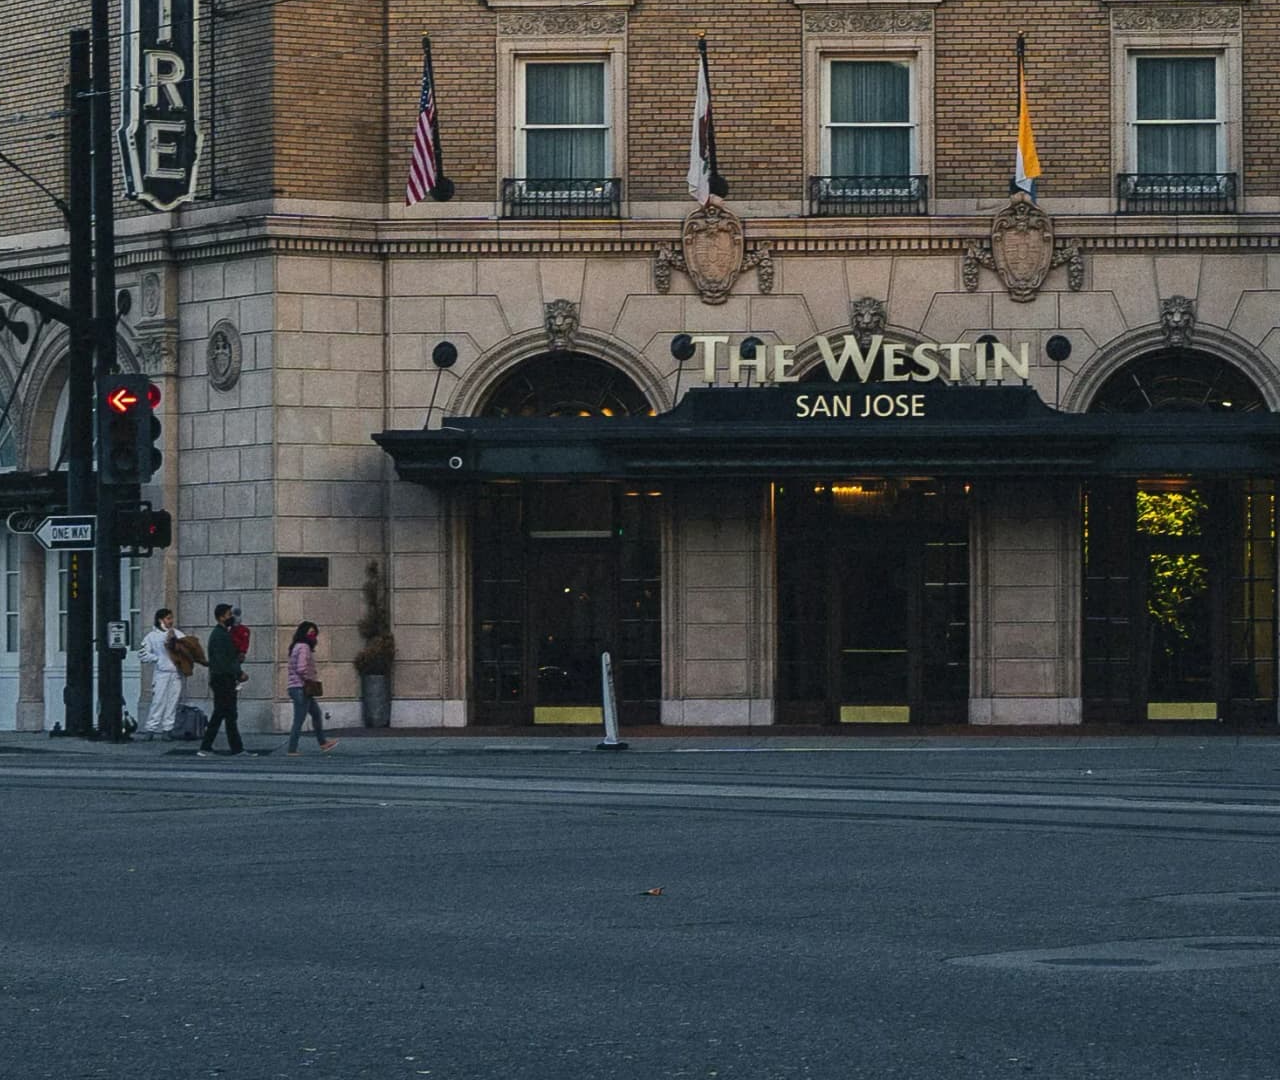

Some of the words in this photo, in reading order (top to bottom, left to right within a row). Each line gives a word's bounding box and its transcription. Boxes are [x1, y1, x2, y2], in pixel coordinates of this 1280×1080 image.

[796, 394, 852, 418] SAN
[860, 394, 926, 418] JOSE
[51, 527, 69, 540] ONE
[71, 527, 89, 539] WAY
